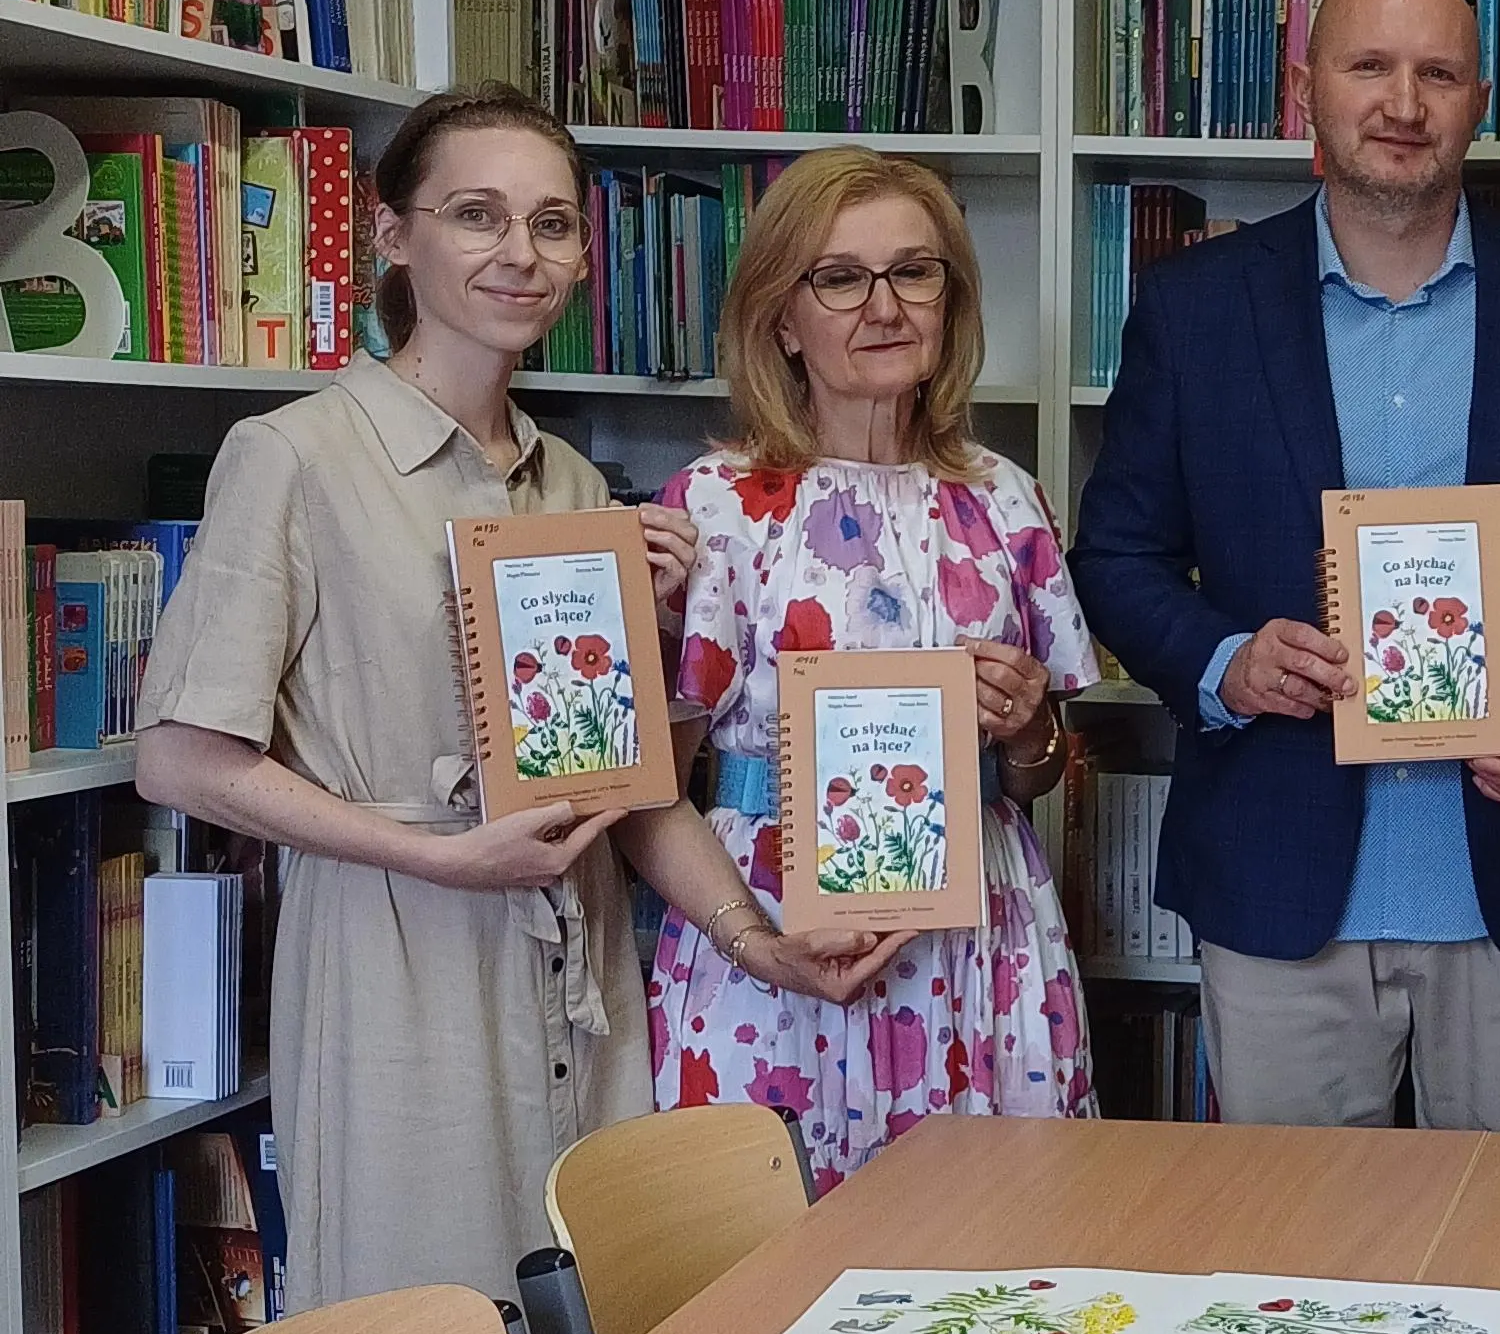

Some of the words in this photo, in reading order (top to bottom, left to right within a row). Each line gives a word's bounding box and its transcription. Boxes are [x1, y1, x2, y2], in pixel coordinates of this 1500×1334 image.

[183, 0, 204, 38] S
[257, 320, 286, 359] T
[1382, 561, 1402, 573] Co
[1403, 557, 1456, 573] słychać
[1394, 576, 1412, 588] na
[520, 595, 539, 611] Co
[542, 590, 596, 608] słychać
[533, 611, 553, 626] na
[839, 725, 859, 739] Co
[861, 722, 918, 739] słychać
[852, 741, 870, 754] na
[97, 1063, 118, 1108] A
